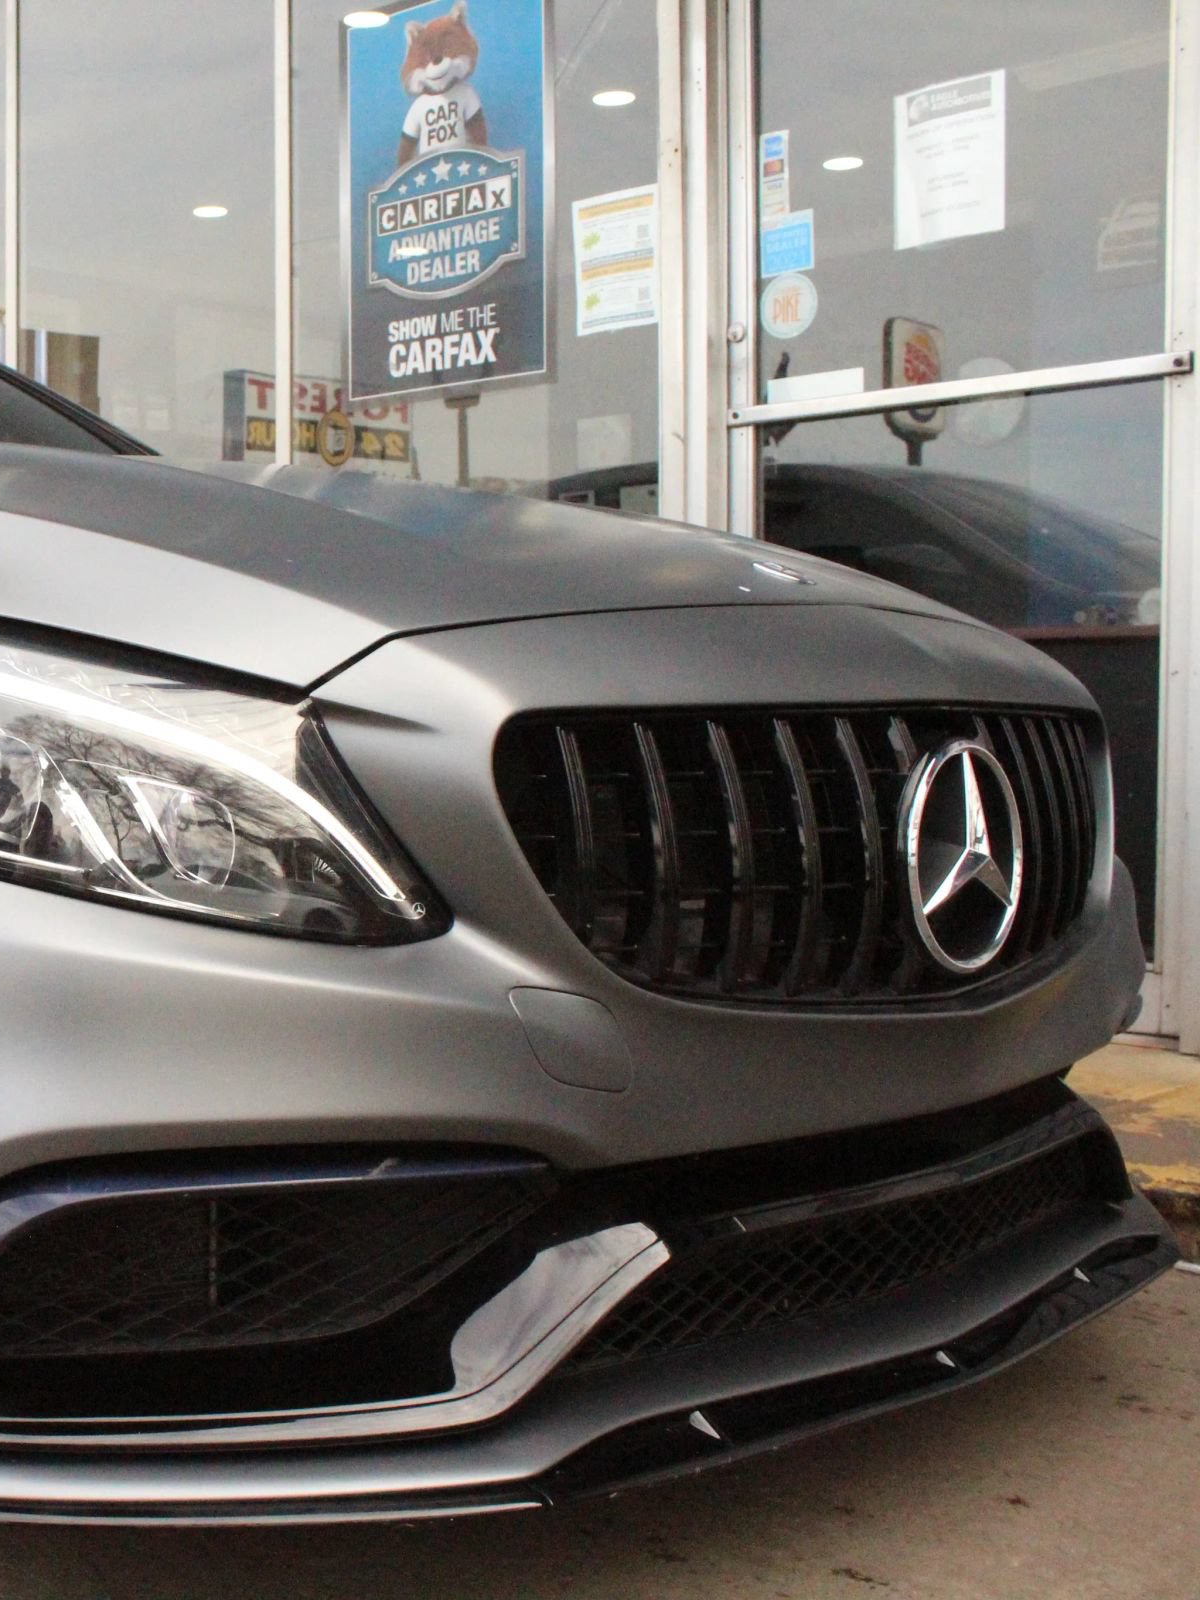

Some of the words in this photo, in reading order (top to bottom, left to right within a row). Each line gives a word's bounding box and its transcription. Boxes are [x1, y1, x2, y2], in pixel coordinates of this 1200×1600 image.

[425, 101, 459, 126] CAR
[427, 122, 459, 146] FOX
[380, 185, 507, 231] CARFAX
[388, 217, 501, 264] ADVANTAGE
[406, 249, 481, 286] DEALER
[388, 314, 437, 343] SHOW
[440, 309, 465, 333] ME
[467, 303, 497, 329] THE
[388, 329, 498, 378] CARFAX
